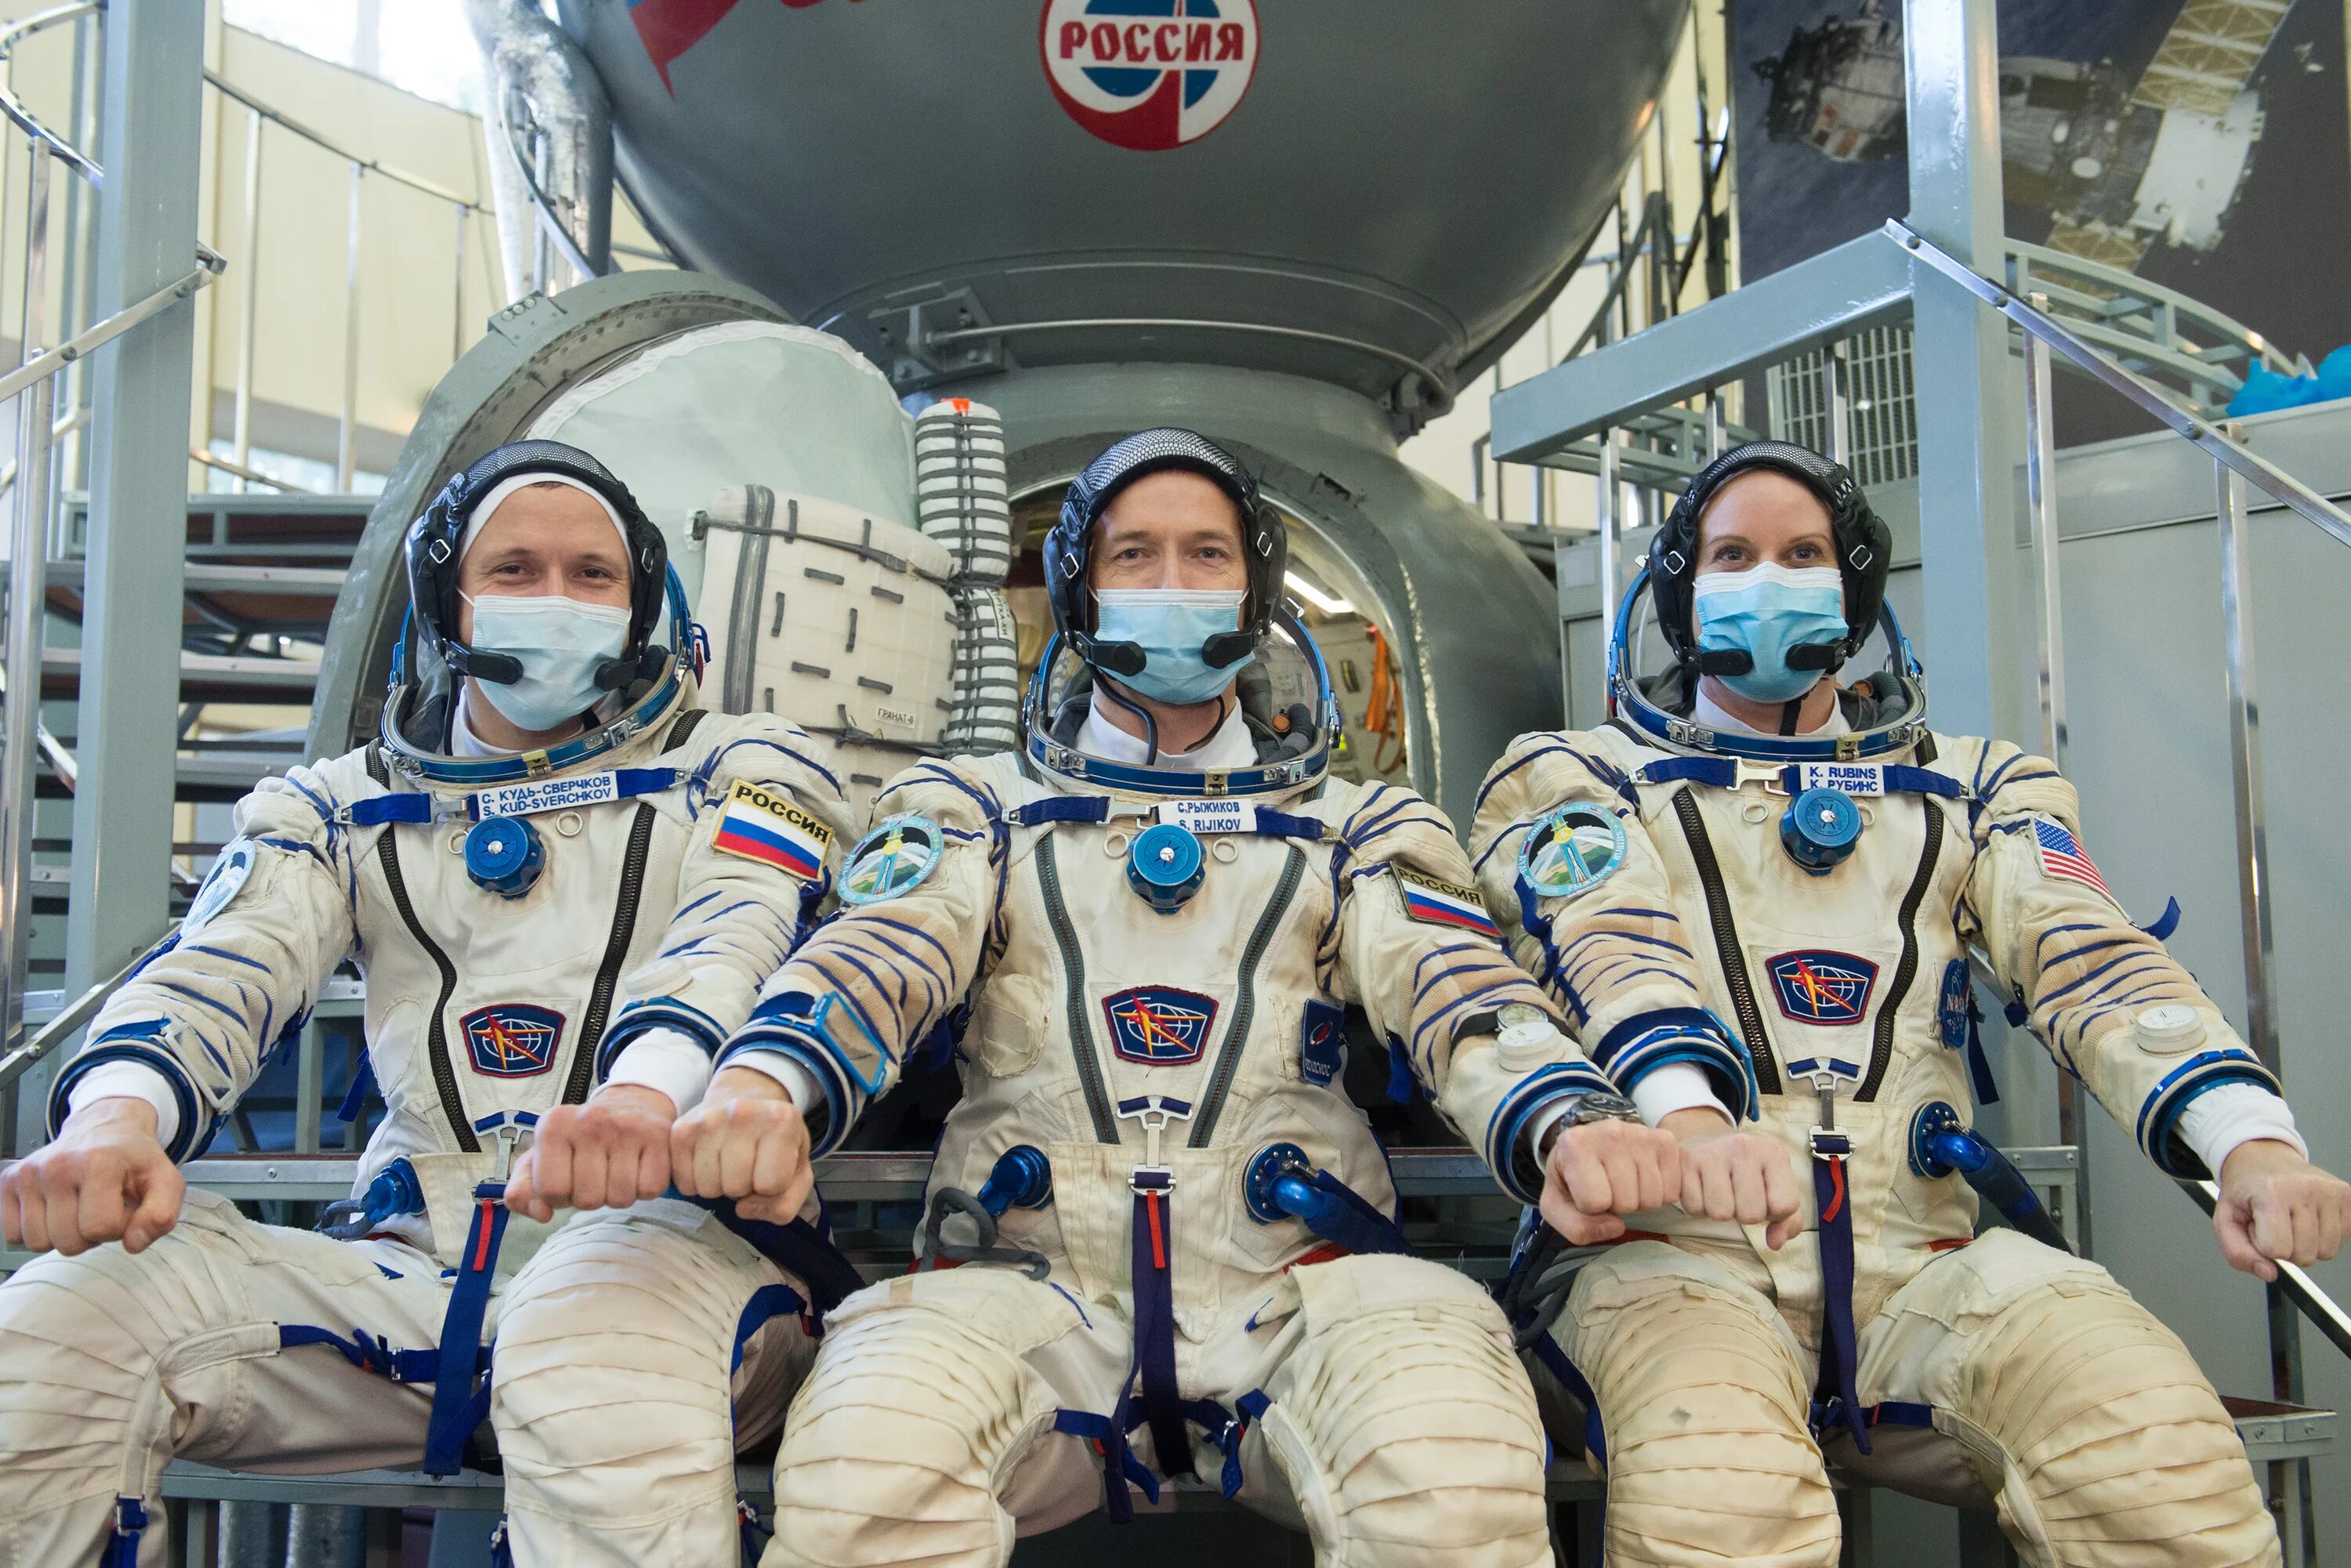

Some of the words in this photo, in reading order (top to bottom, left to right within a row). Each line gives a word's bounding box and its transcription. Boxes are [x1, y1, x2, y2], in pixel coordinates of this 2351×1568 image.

[1060, 21, 1244, 62] РОССИЯ
[1809, 766, 1823, 777] K.
[1829, 767, 1877, 779] RUBINS
[1828, 780, 1878, 792] РУБИНС
[481, 793, 495, 805] С.
[499, 776, 611, 802] КУДЬ-СВЕРЧКОВ
[483, 806, 495, 817] S.
[499, 788, 611, 814] KUD-SVERCHKOV
[735, 785, 829, 844] РОССИЯ
[1194, 819, 1241, 831] RIJIKOV
[1397, 867, 1482, 905] РОССИЯ
